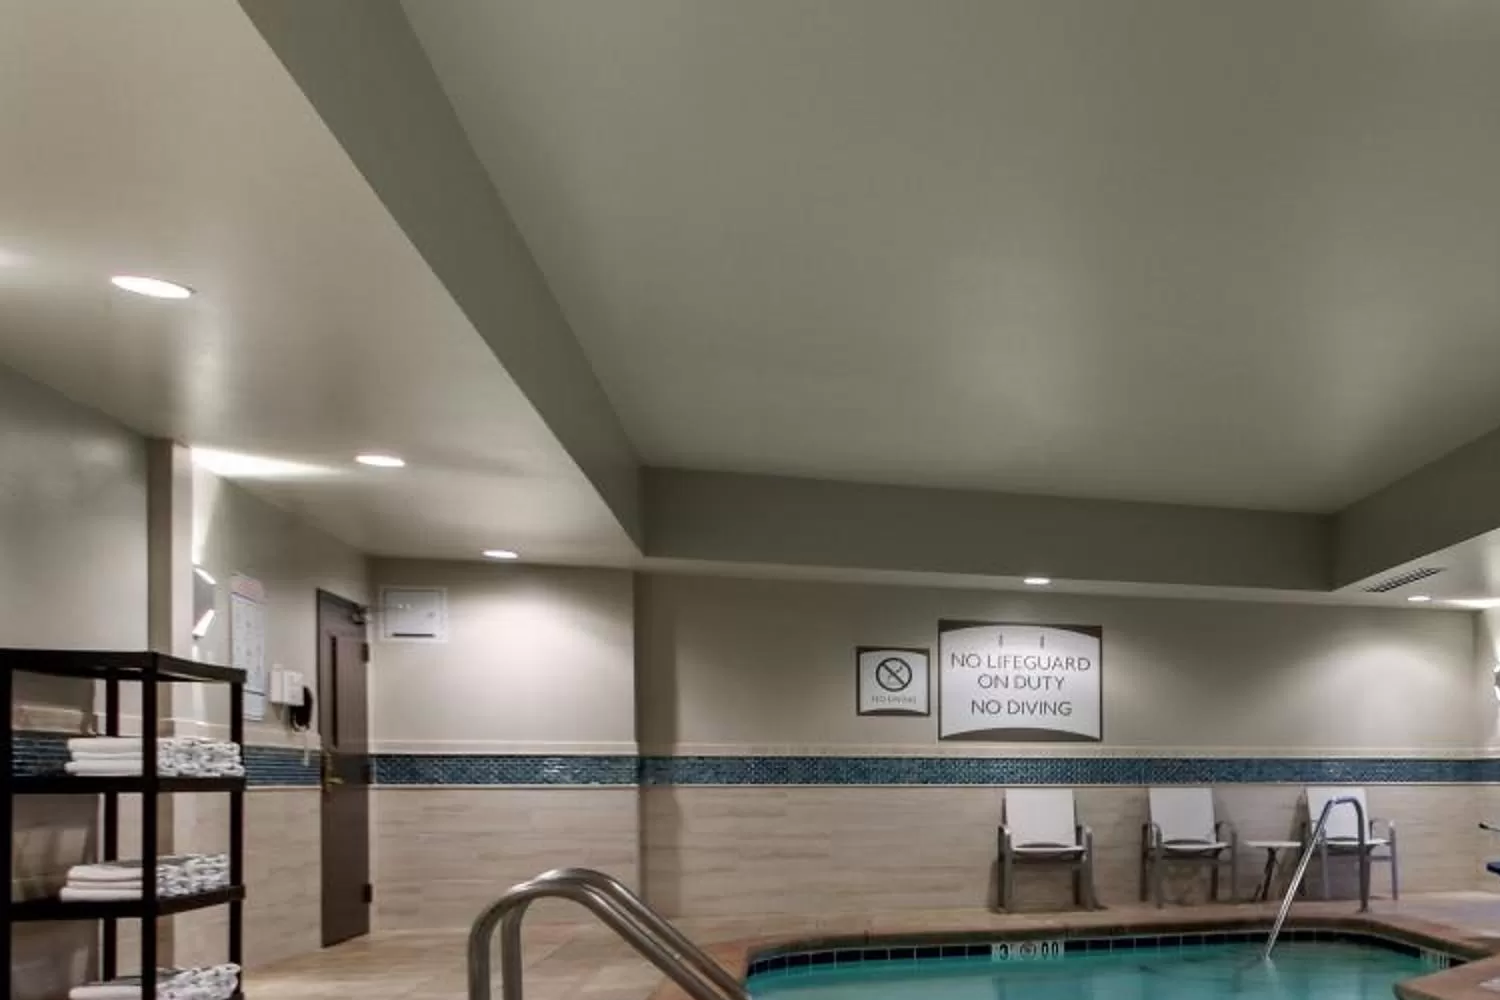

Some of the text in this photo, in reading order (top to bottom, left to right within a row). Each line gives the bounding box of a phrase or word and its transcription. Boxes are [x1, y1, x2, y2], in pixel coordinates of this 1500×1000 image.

[951, 652, 1091, 671] NO LIFEGUARD
[977, 674, 1065, 691] ON DUTY
[971, 699, 1073, 716] NO DIVING
